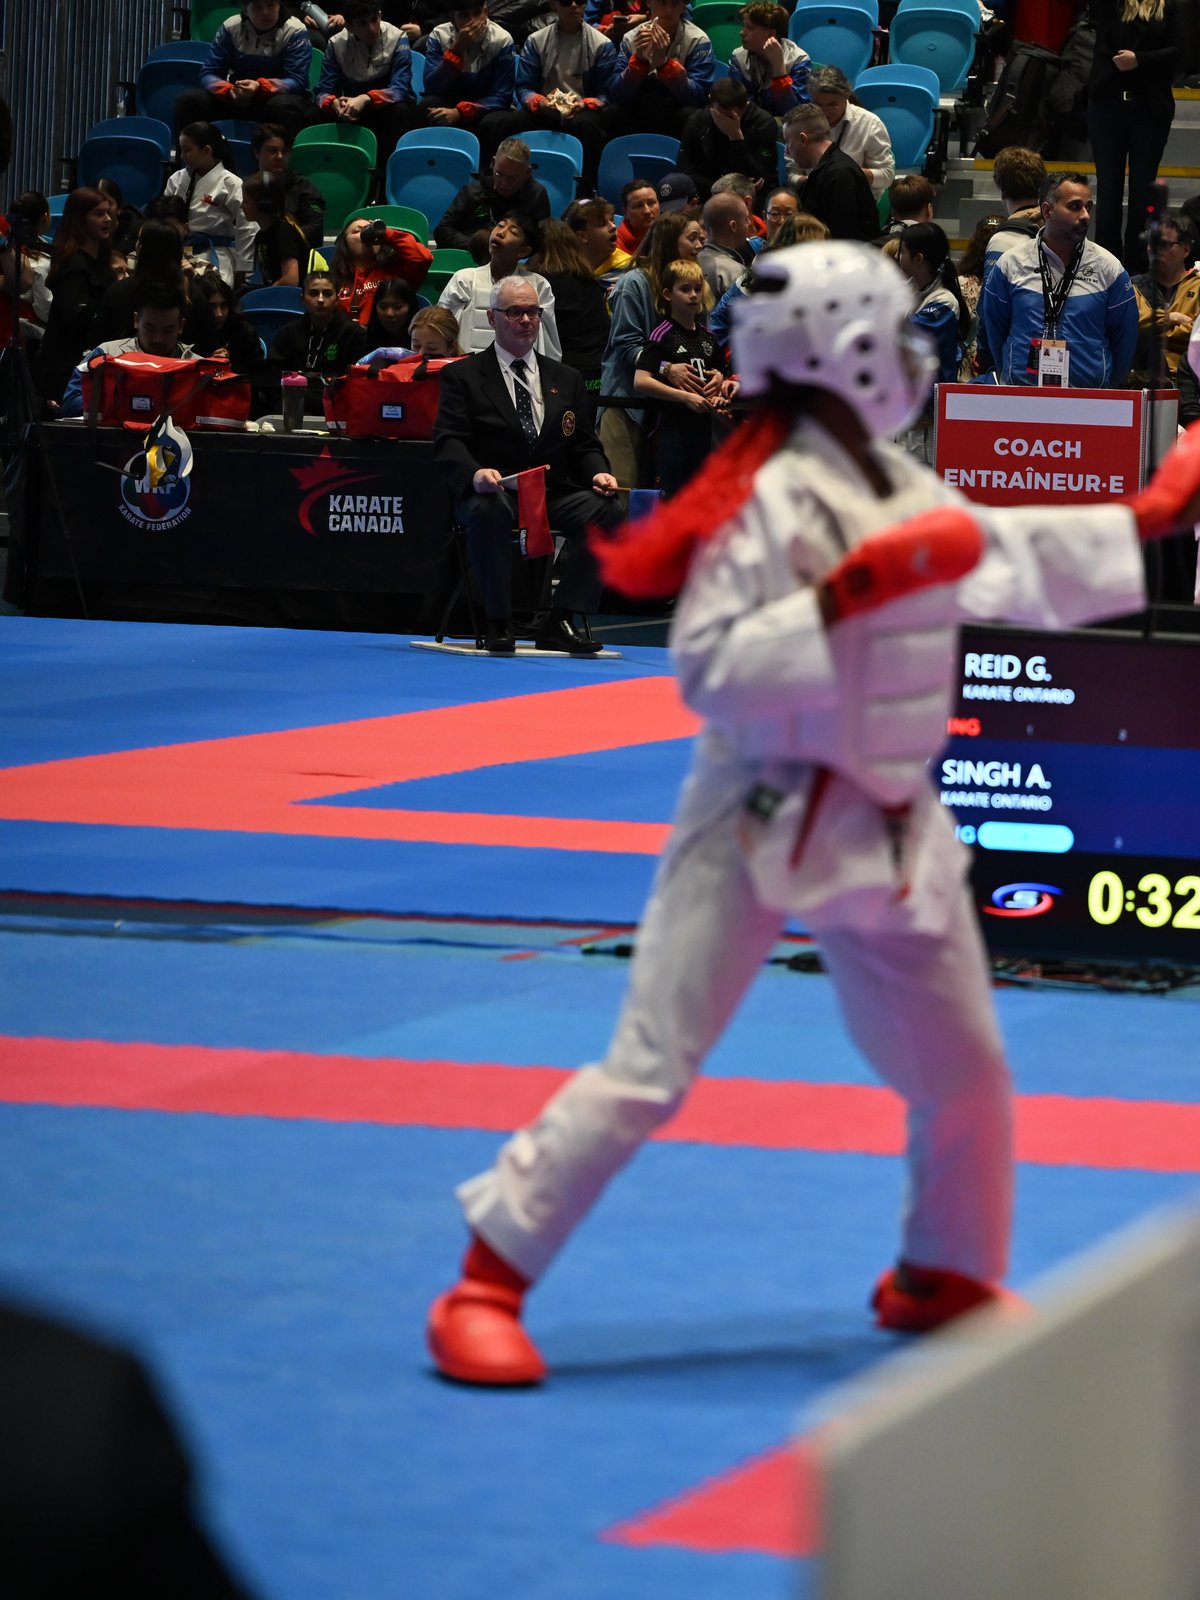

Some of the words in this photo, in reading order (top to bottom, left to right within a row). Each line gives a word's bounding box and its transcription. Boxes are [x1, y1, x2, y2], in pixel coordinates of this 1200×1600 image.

[993, 437, 1082, 459] COACH
[329, 494, 404, 514] KARATE
[117, 504, 145, 529] KARATE
[146, 506, 192, 531] FEDERATION
[328, 514, 404, 533] CANADA
[964, 653, 1021, 679] REID
[1025, 655, 1052, 682] G.
[962, 684, 1013, 701] KARATE
[1013, 686, 1075, 704] ONTARIO
[941, 759, 1021, 788] SINGH
[1025, 763, 1052, 790] A.
[990, 793, 1052, 811] ONTARIO
